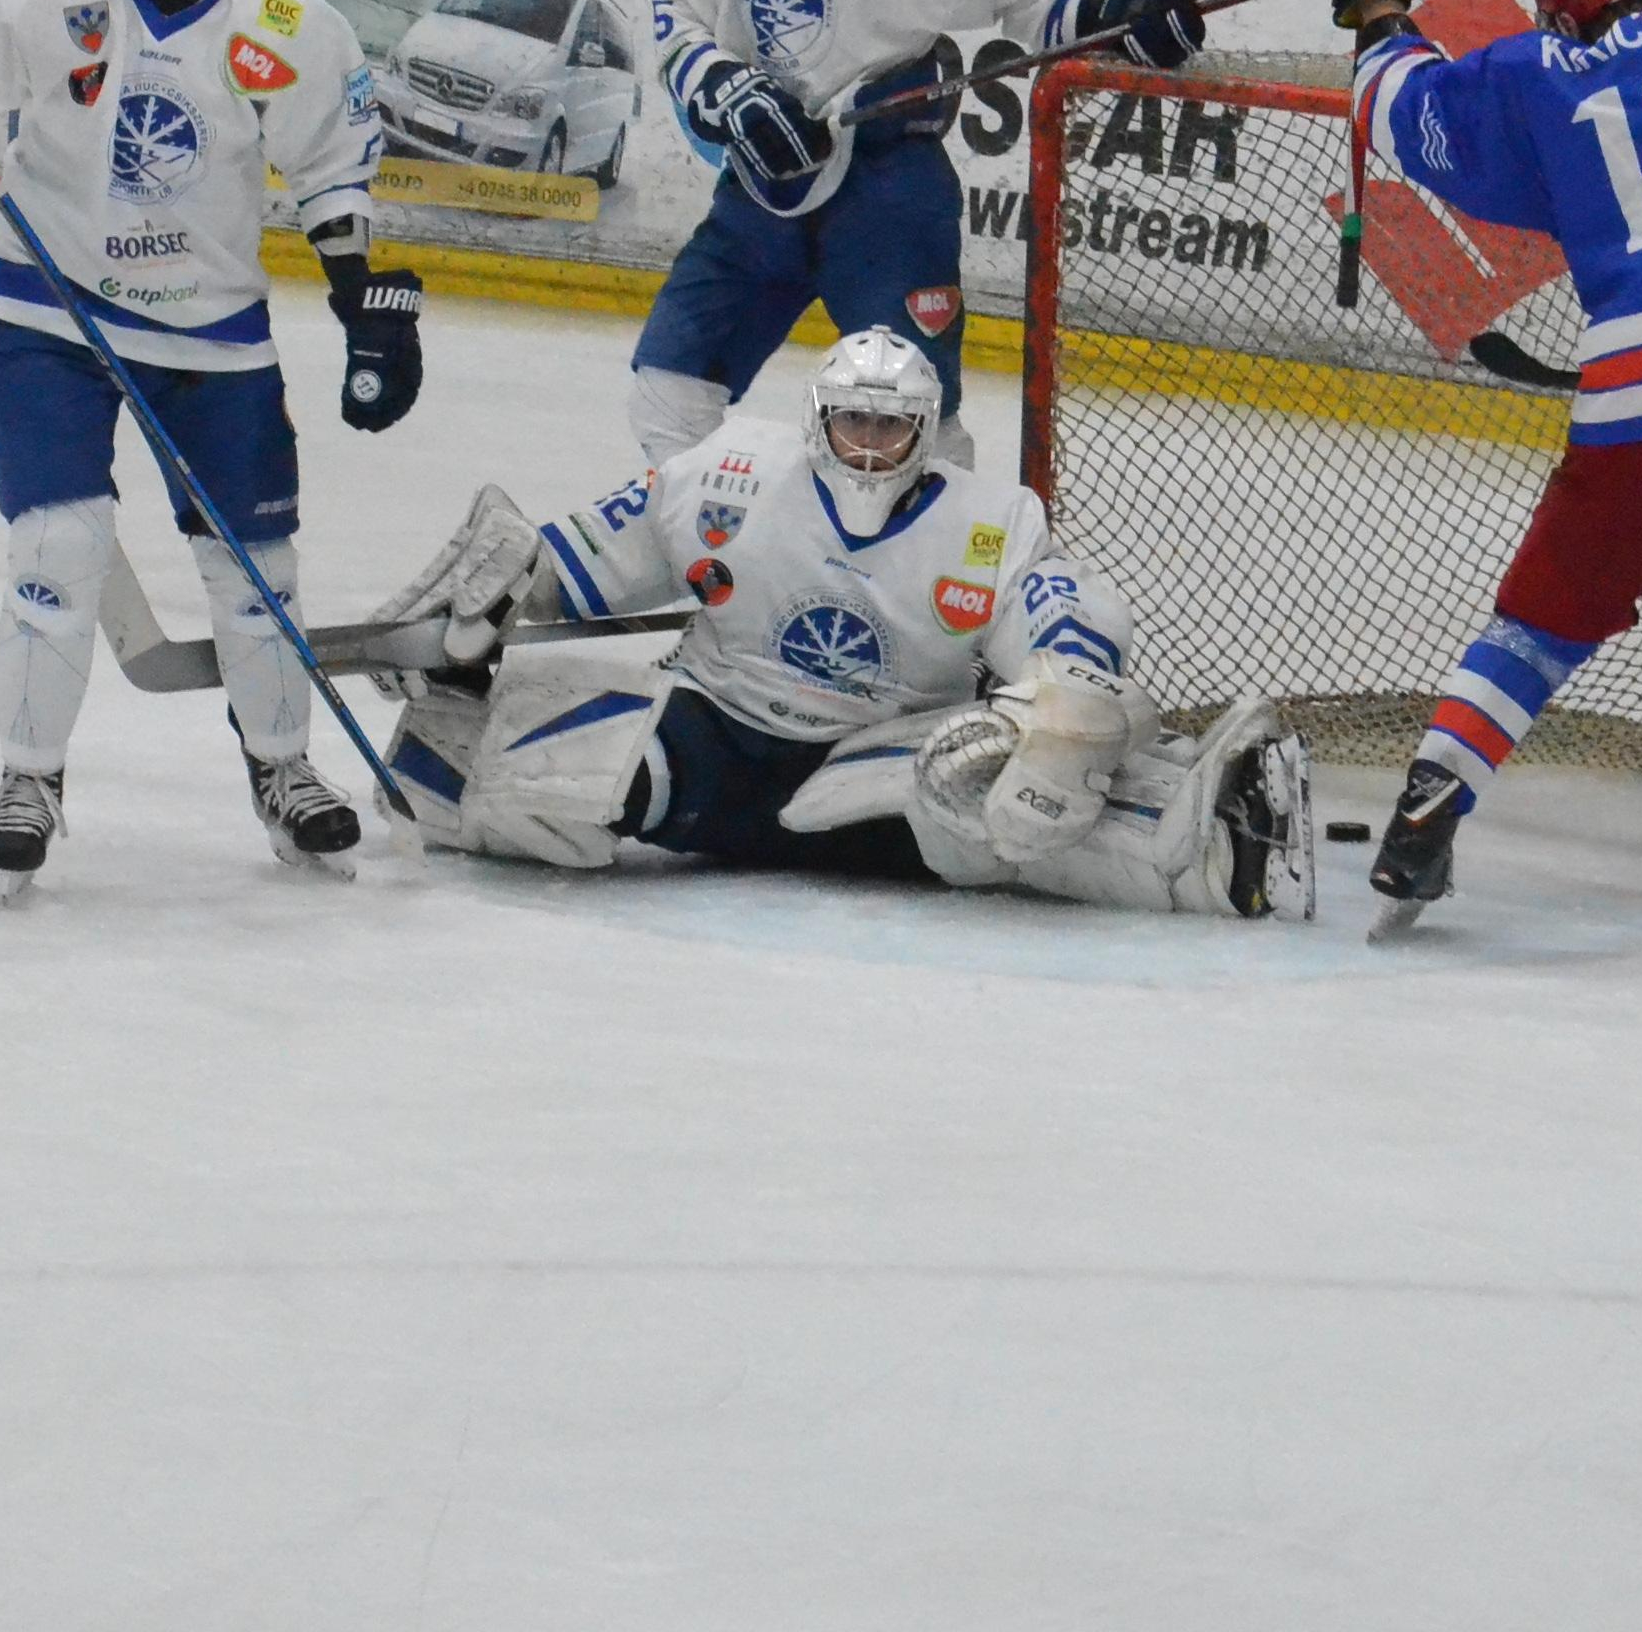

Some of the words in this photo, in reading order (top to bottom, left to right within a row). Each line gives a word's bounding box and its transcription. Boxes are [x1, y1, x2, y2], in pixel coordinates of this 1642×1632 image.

[234, 43, 275, 80] MOL
[542, 188, 582, 208] 0000
[105, 231, 194, 259] BORSEC
[917, 292, 950, 313] MOL
[940, 584, 990, 615] MOL
[1020, 571, 1081, 616] 22
